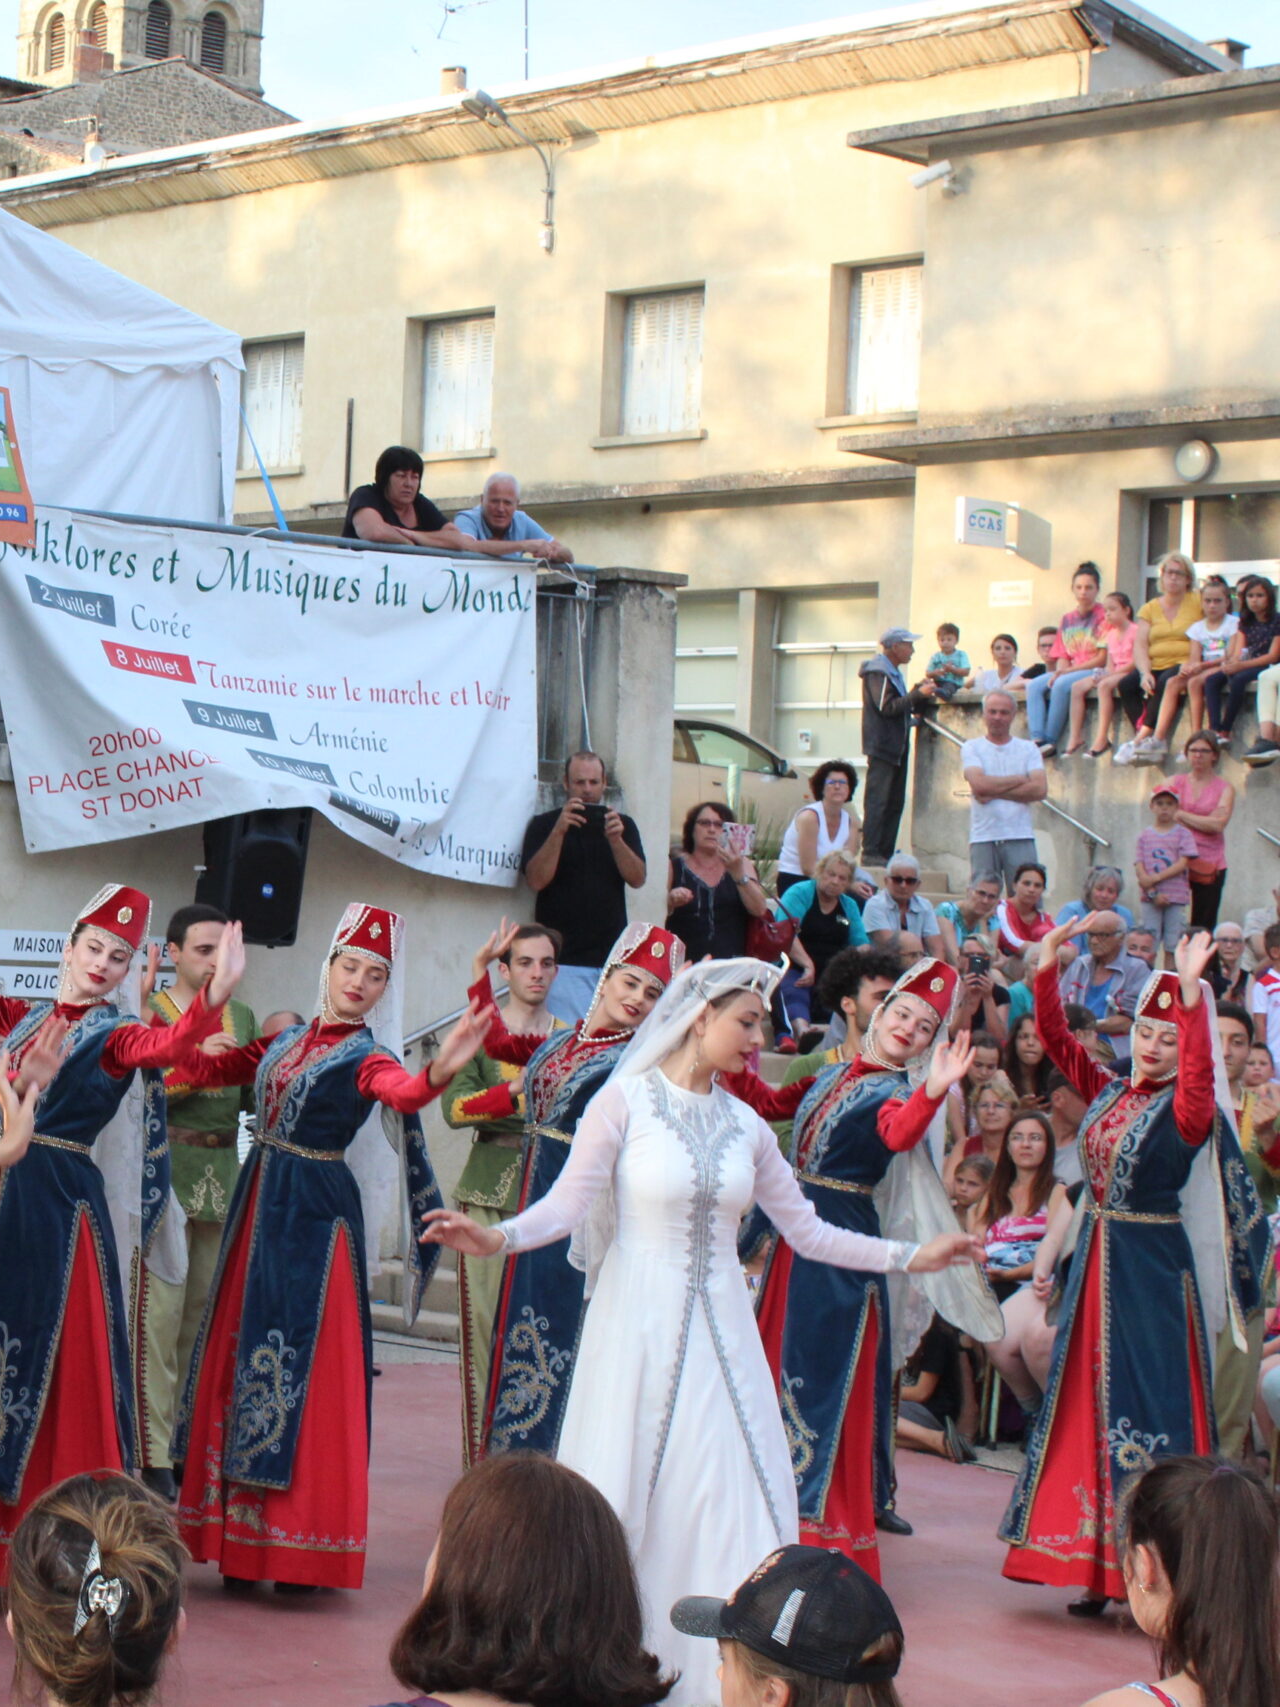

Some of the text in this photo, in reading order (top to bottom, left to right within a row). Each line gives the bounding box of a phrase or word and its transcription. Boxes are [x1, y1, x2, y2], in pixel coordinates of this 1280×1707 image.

[6, 507, 20, 518] 96
[968, 514, 1003, 532] CCAS
[152, 548, 180, 585] et
[196, 546, 361, 616] Musiques
[375, 564, 407, 608] du
[39, 584, 192, 639] 2 Juillet Corée
[116, 648, 129, 666] 8
[133, 652, 183, 677] Juillet
[196, 660, 299, 698] Tanzanie
[306, 678, 337, 702] sur
[342, 676, 362, 703] le
[450, 685, 469, 706] et
[88, 727, 163, 757] 20h00
[197, 707, 390, 753] 9 Juillet Arménie
[28, 766, 112, 796] PLACE
[81, 776, 205, 820] ST DONAT
[257, 754, 279, 769] 10
[348, 770, 450, 805] Colombie
[13, 936, 65, 953] MAISON
[13, 973, 59, 990] POLIC
